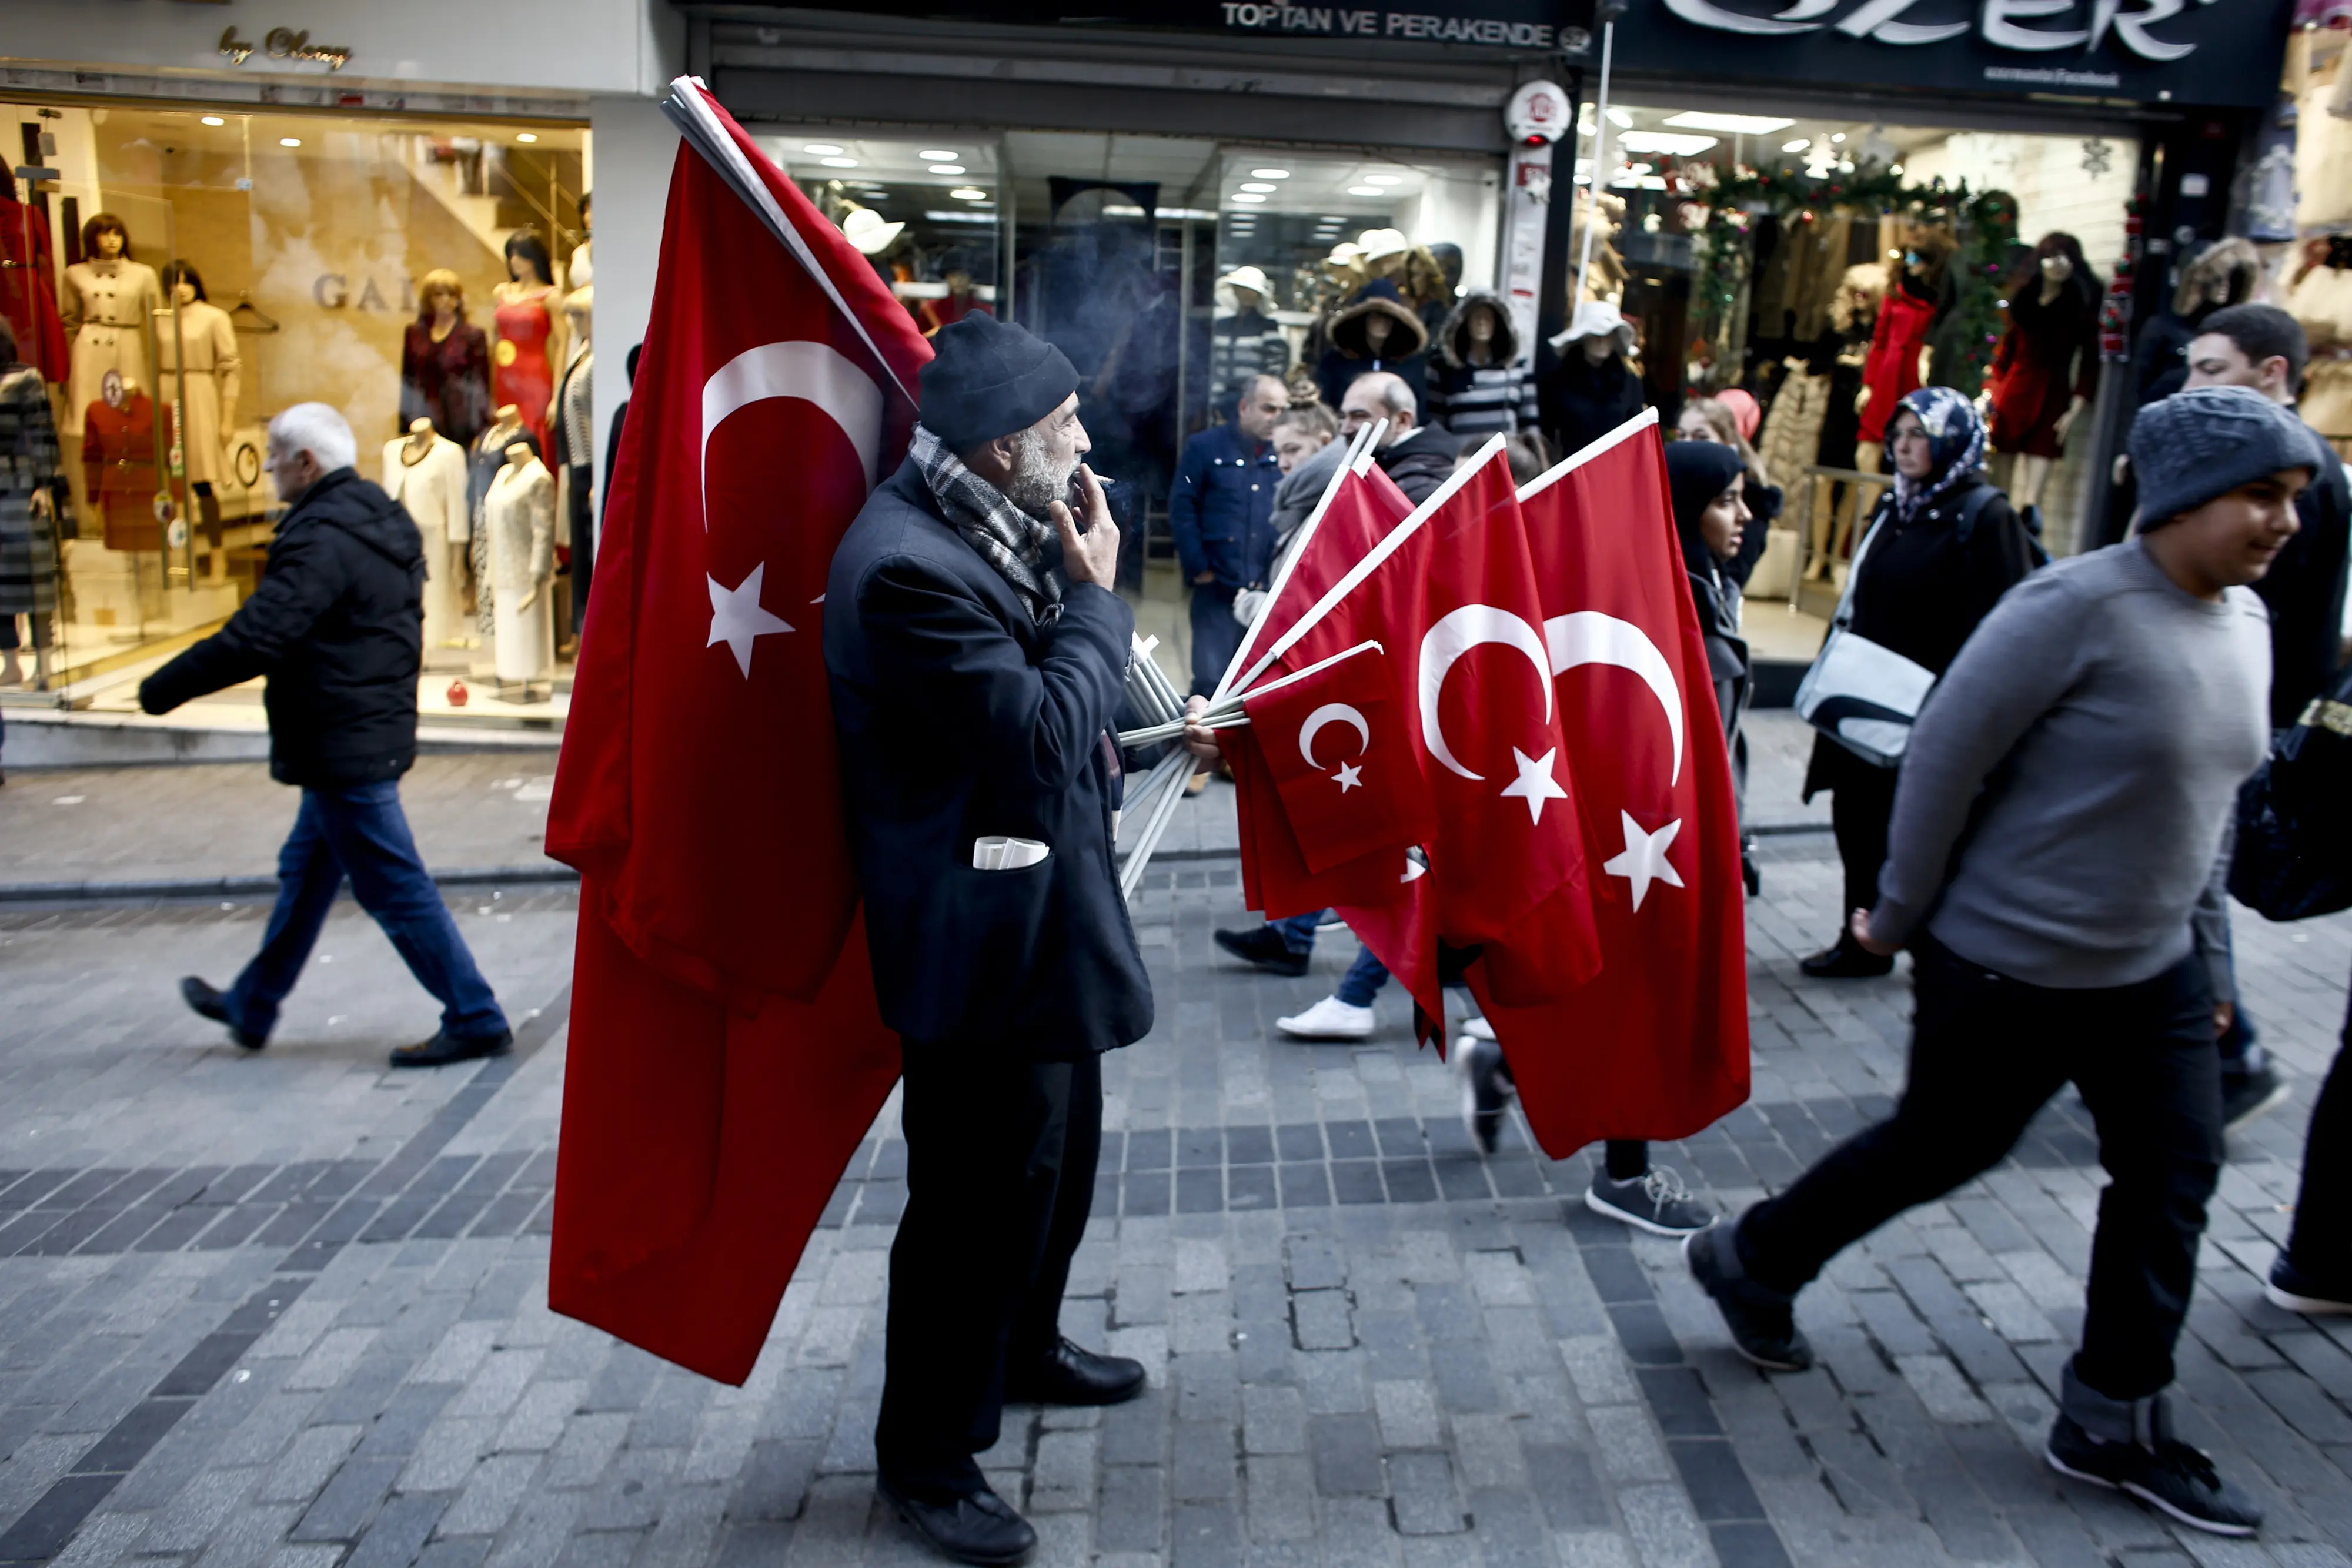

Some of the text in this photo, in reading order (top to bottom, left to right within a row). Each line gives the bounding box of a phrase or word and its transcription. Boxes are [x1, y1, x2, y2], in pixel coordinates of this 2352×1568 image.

[1220, 2, 1332, 31] TOPTAN
[1338, 9, 1378, 34] VE
[1385, 12, 1554, 48] PERAKENDE
